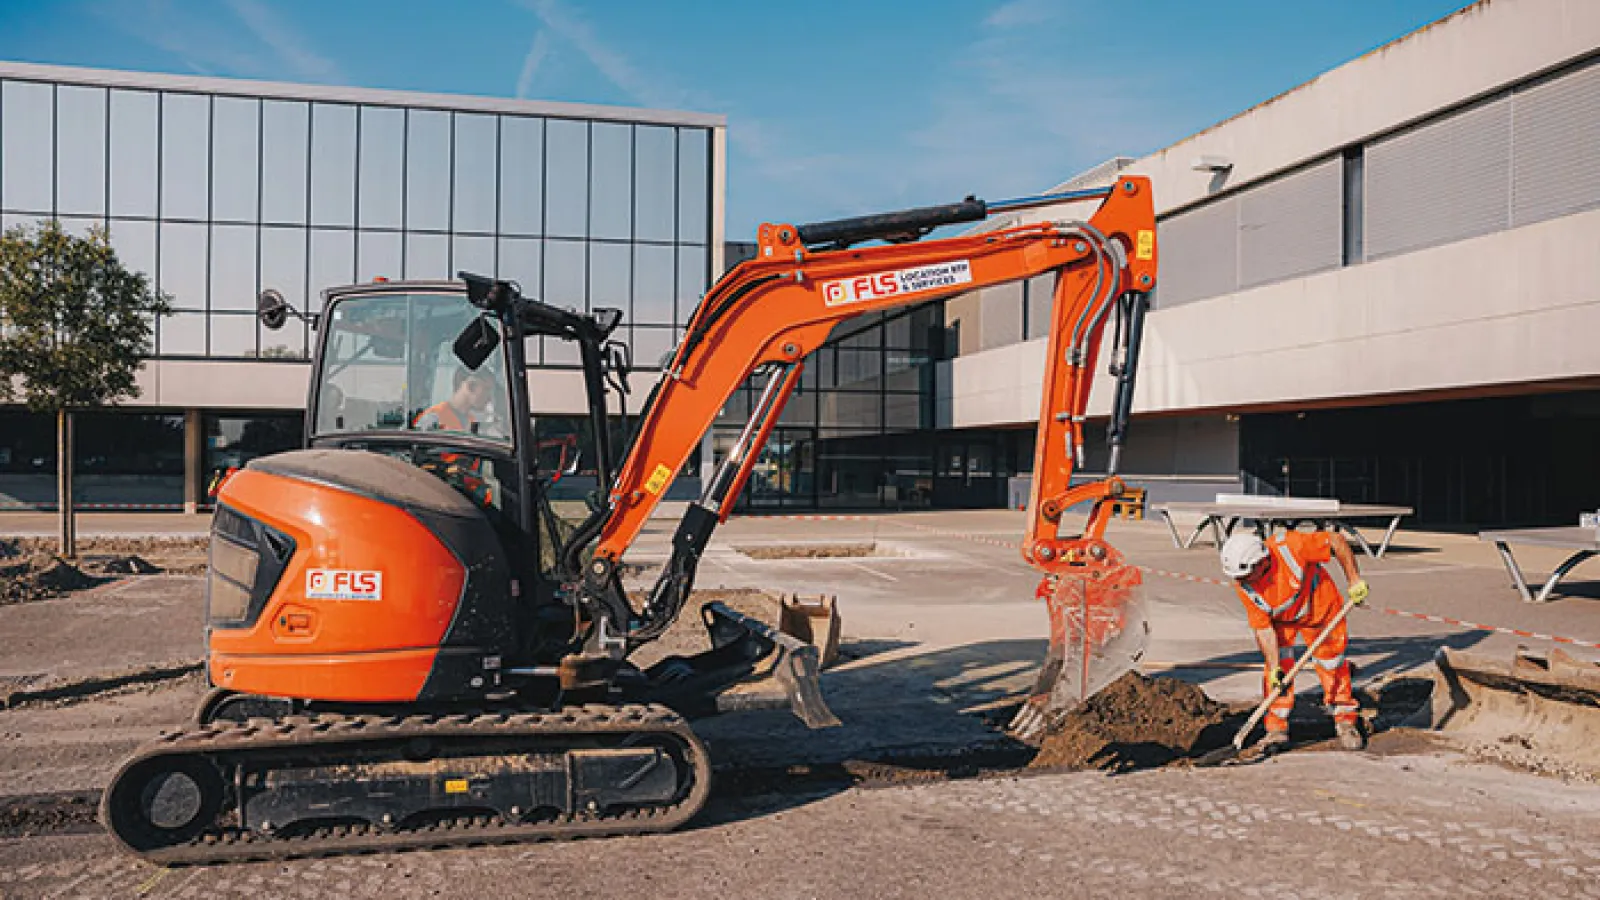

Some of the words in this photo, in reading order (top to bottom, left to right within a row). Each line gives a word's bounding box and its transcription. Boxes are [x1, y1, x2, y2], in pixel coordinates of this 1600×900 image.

[901, 268, 949, 282] LOCATION
[912, 275, 956, 290] SERVICES
[854, 274, 897, 299] FLS
[334, 573, 376, 592] FLS
